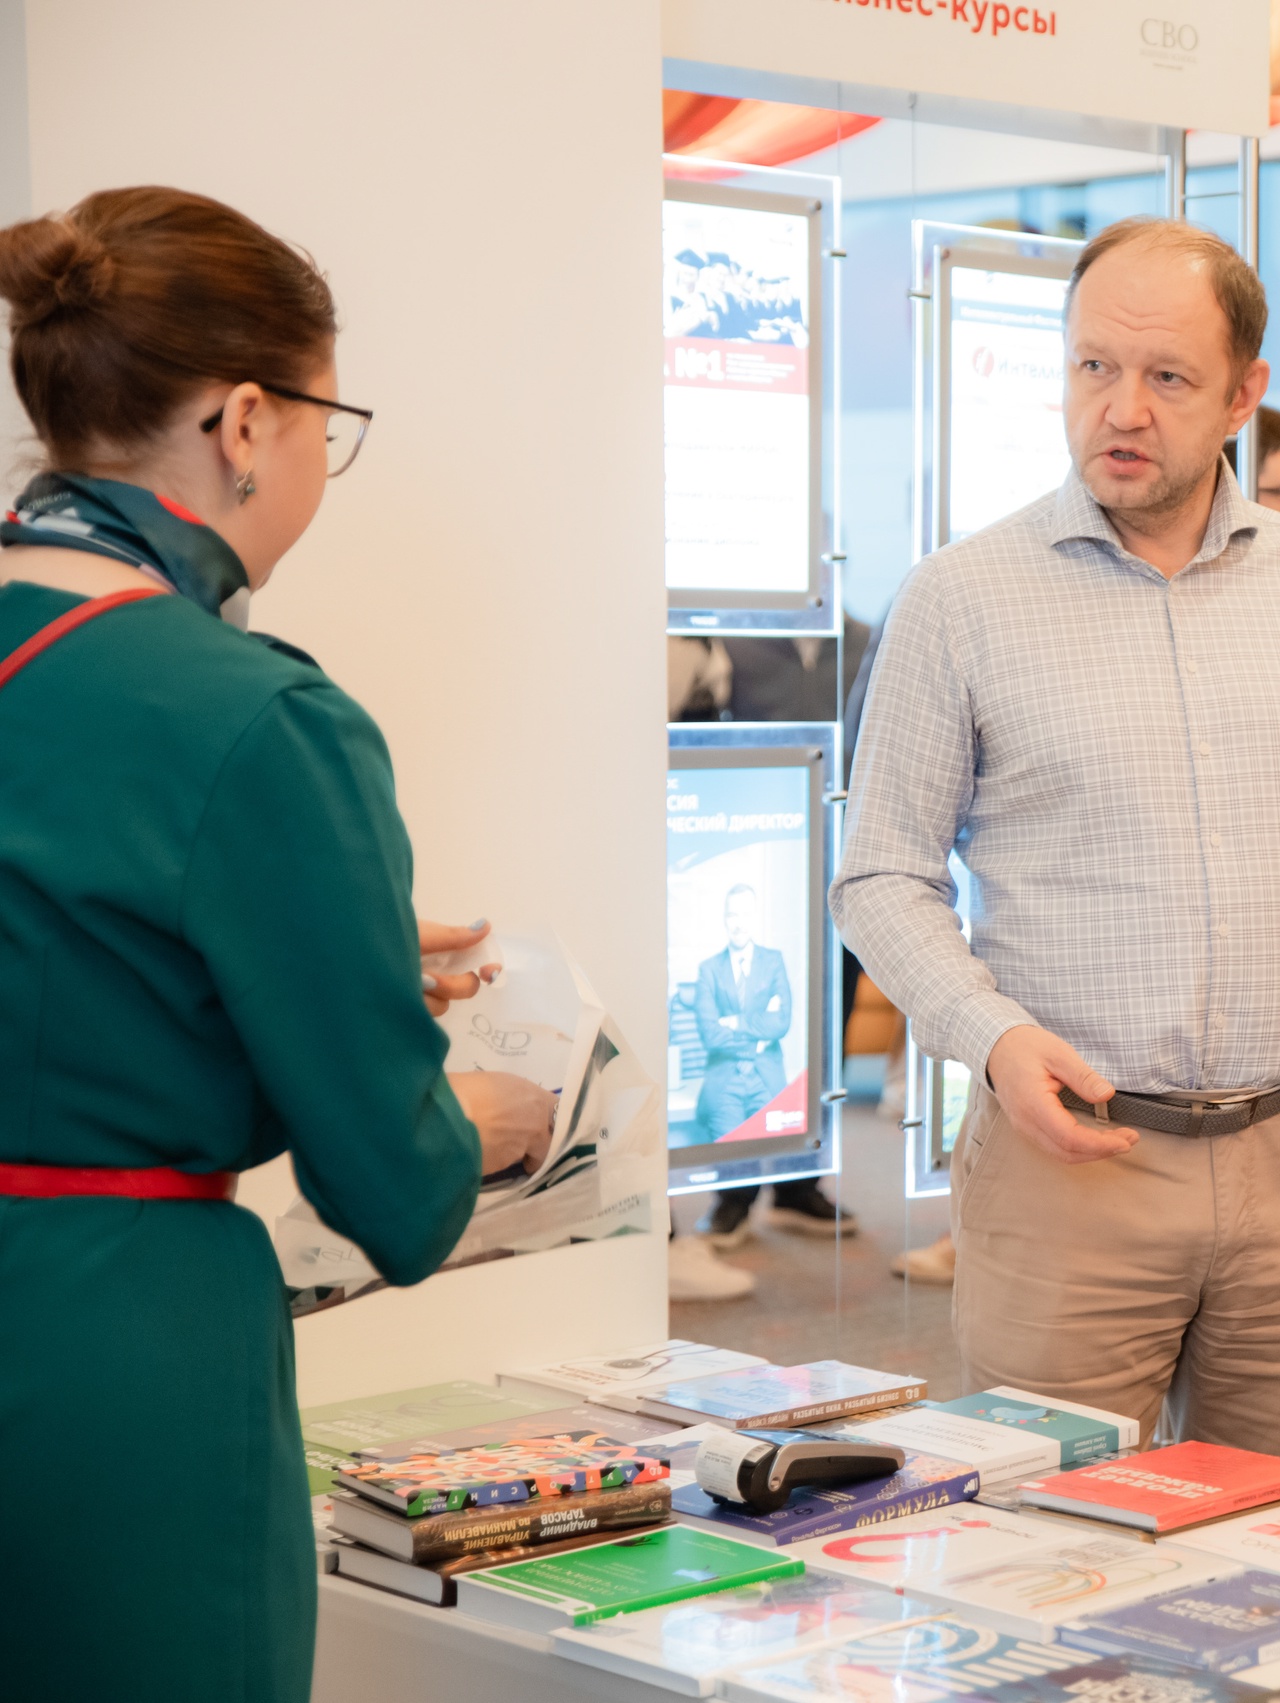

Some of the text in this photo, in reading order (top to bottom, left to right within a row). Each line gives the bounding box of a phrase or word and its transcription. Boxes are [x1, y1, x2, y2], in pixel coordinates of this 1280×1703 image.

[817, 0, 1057, 36] ес-курсы
[675, 348, 724, 381] №1
[728, 813, 804, 833] ДИРЕКТОР
[793, 1406, 825, 1420] РАЗБИТЫЕ
[844, 1396, 876, 1410] РАЗБИТЫЙ
[877, 1391, 900, 1403] БИЗНЕС
[1076, 1470, 1205, 1500] продает
[1094, 1465, 1225, 1495] каждый
[540, 1508, 585, 1523] ТАРАСОВ
[856, 1490, 951, 1528] ФОРМУЛА
[444, 1521, 515, 1542] МАКИАВЕЛЛИ
[463, 1529, 530, 1550] УПРАВЛЕНИЕ
[539, 1518, 598, 1537] ВЛАДИМИР
[790, 1522, 842, 1543] Рональд Фергюсон
